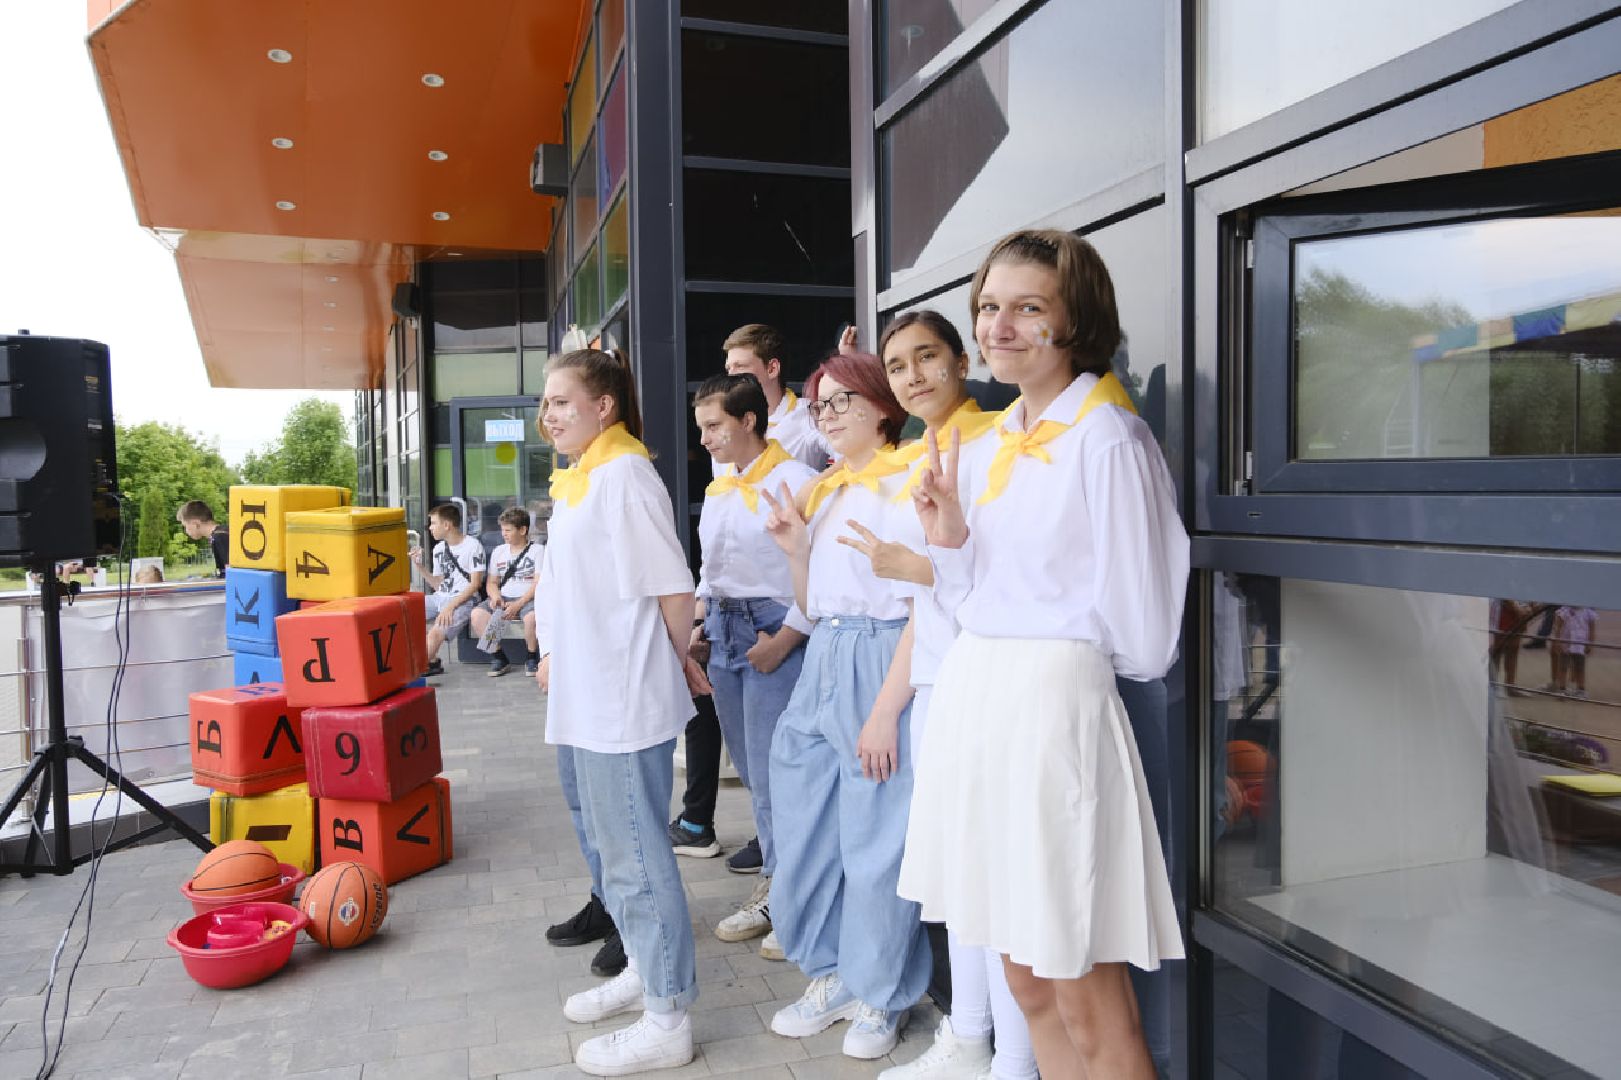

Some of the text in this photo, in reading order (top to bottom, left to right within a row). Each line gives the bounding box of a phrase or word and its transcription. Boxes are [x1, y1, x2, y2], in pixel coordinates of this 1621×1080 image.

[240, 499, 267, 560] Ю
[296, 550, 330, 579] 4
[335, 732, 360, 777] 9
